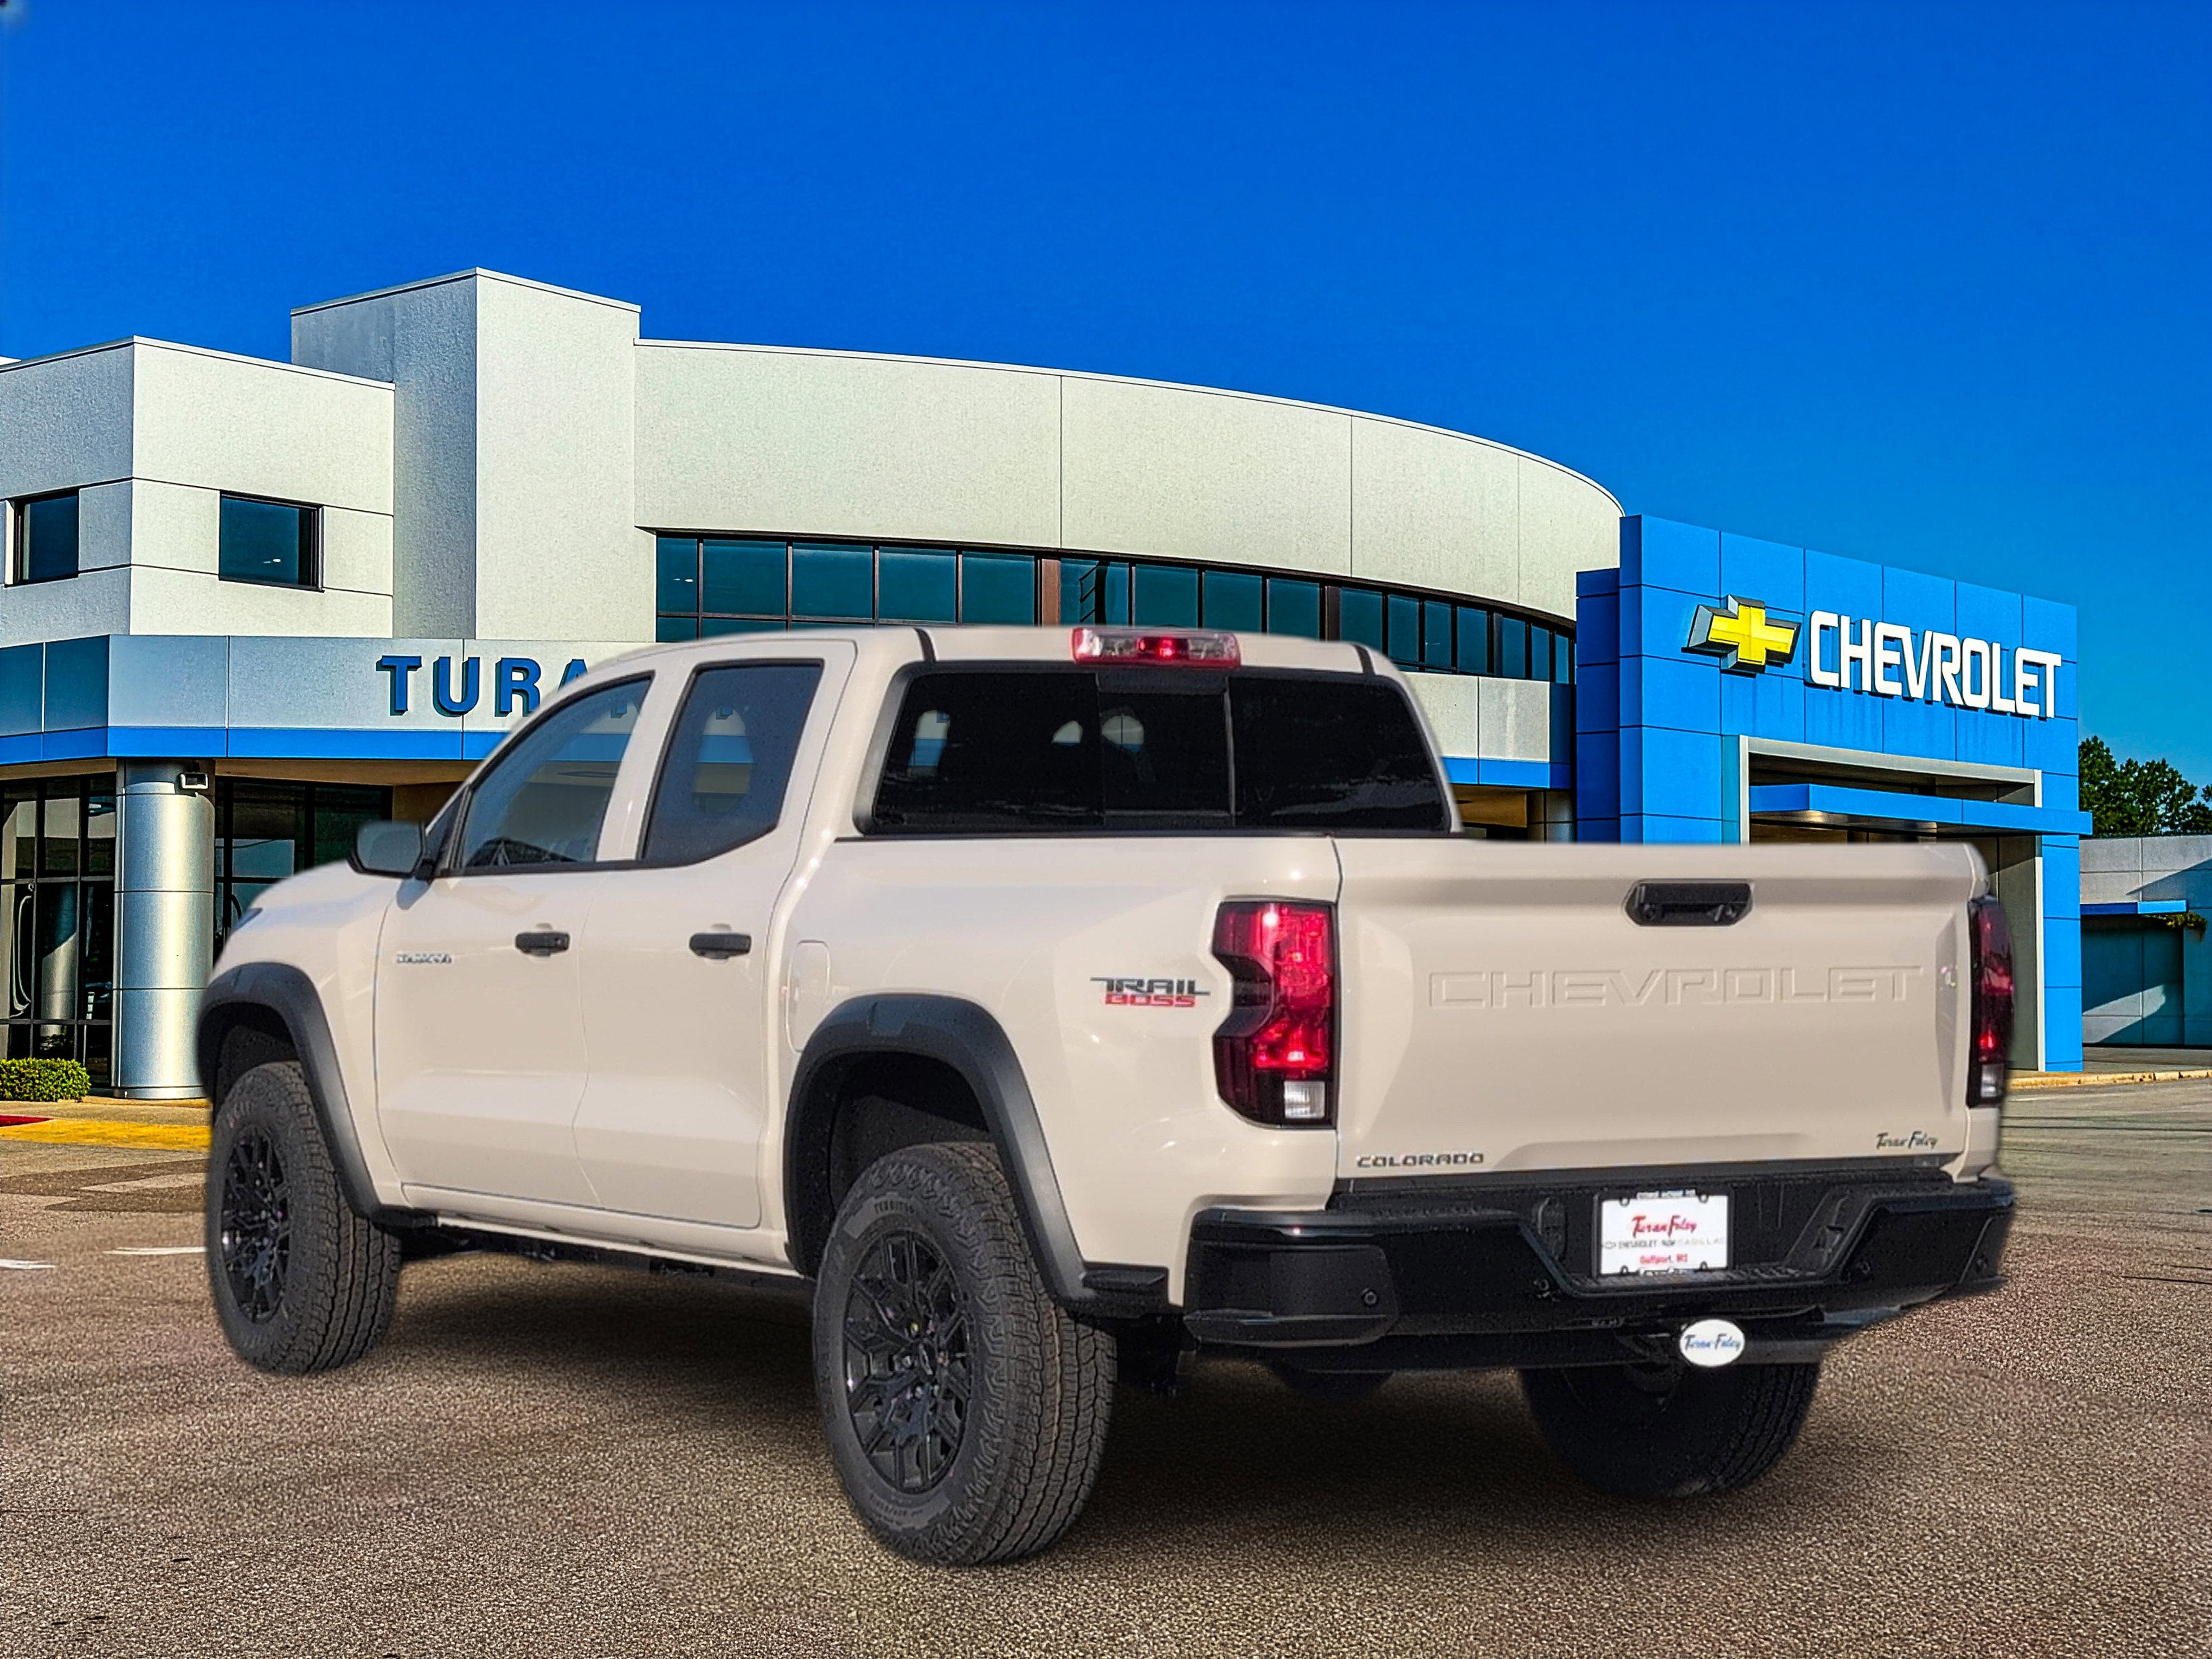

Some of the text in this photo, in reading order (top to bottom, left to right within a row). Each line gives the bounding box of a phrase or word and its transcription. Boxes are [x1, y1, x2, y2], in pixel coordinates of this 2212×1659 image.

[1809, 610, 2062, 718] CHEVROLET
[1090, 978, 1210, 995] TRAIL
[1428, 965, 1924, 1008] CHEVROLET
[1105, 994, 1195, 1007] BOSS
[1356, 1153, 1484, 1167] COLORADO
